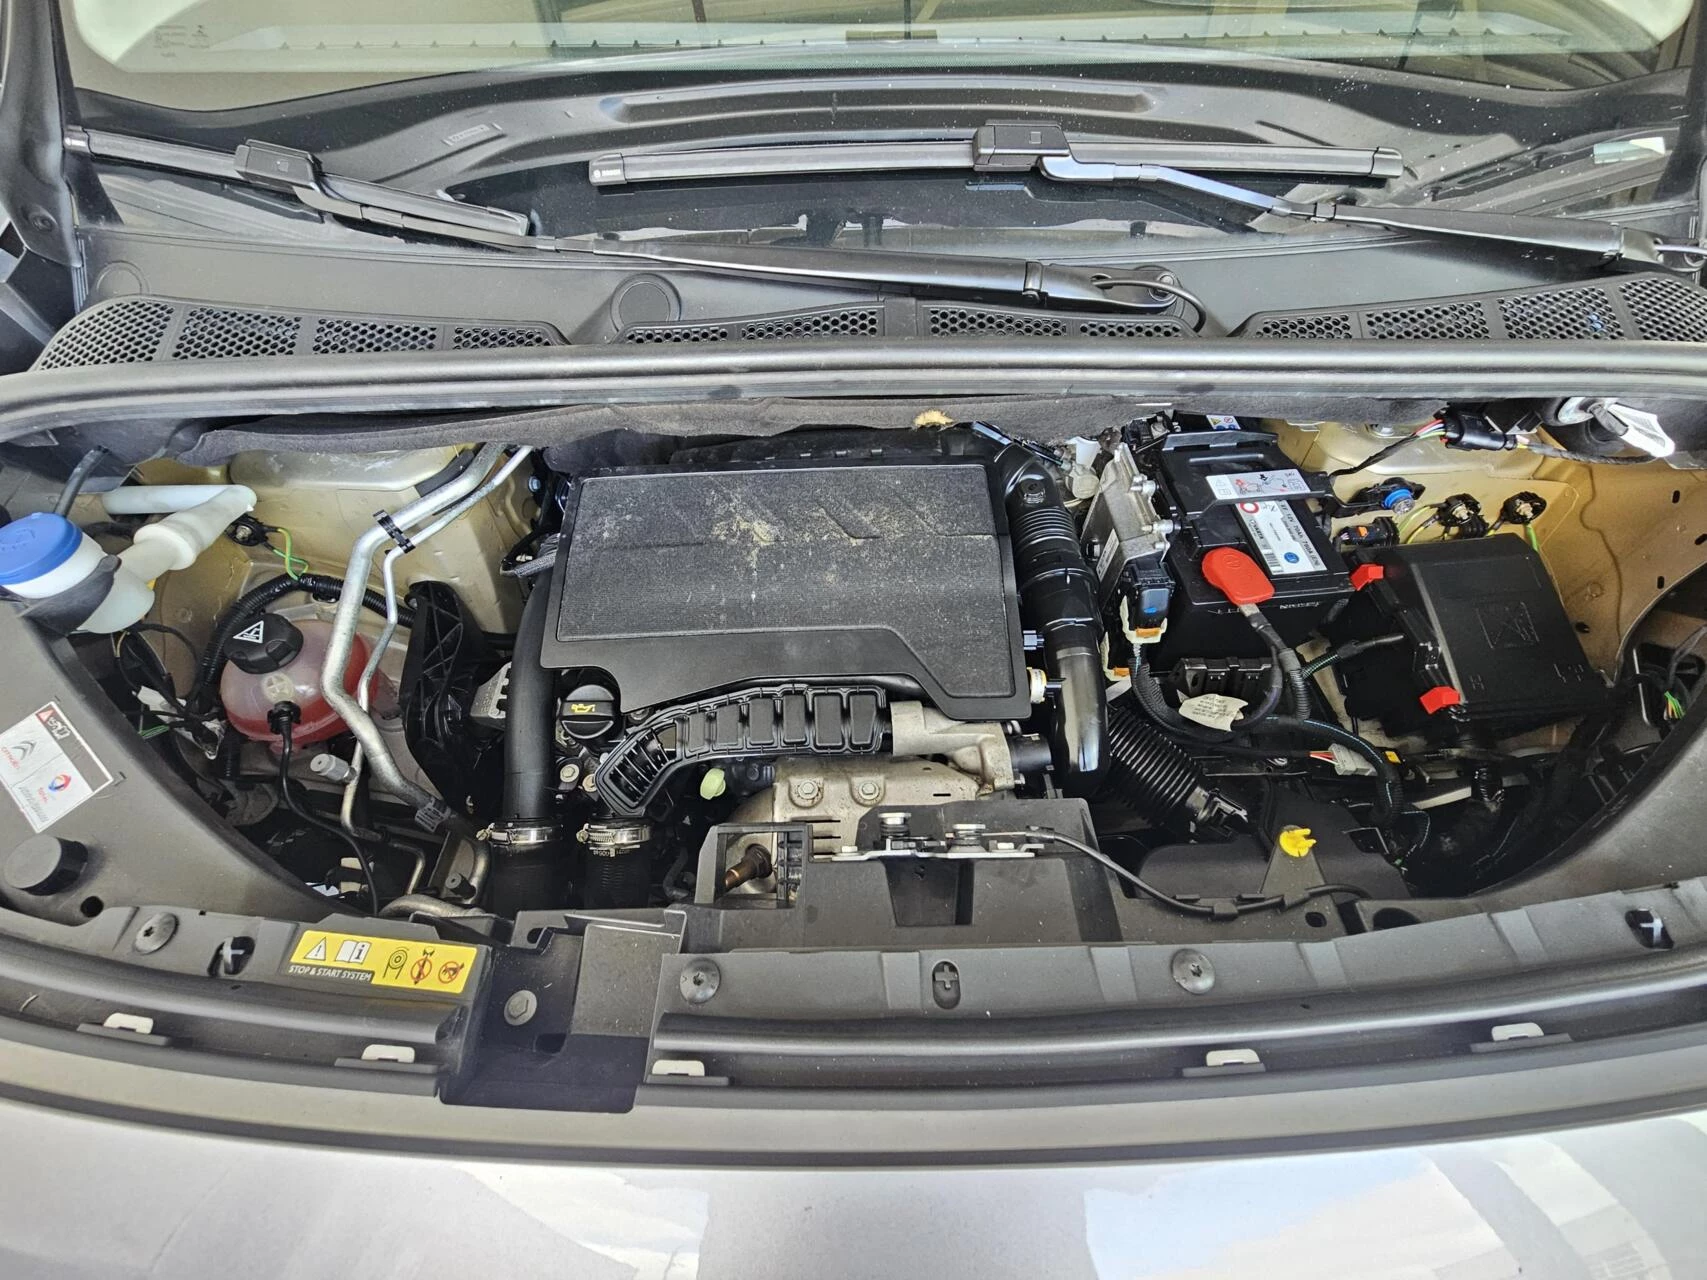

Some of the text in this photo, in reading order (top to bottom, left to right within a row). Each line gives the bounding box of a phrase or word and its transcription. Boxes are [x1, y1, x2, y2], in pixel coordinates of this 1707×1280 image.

[289, 965, 372, 981] STOP & START SYSTEM
